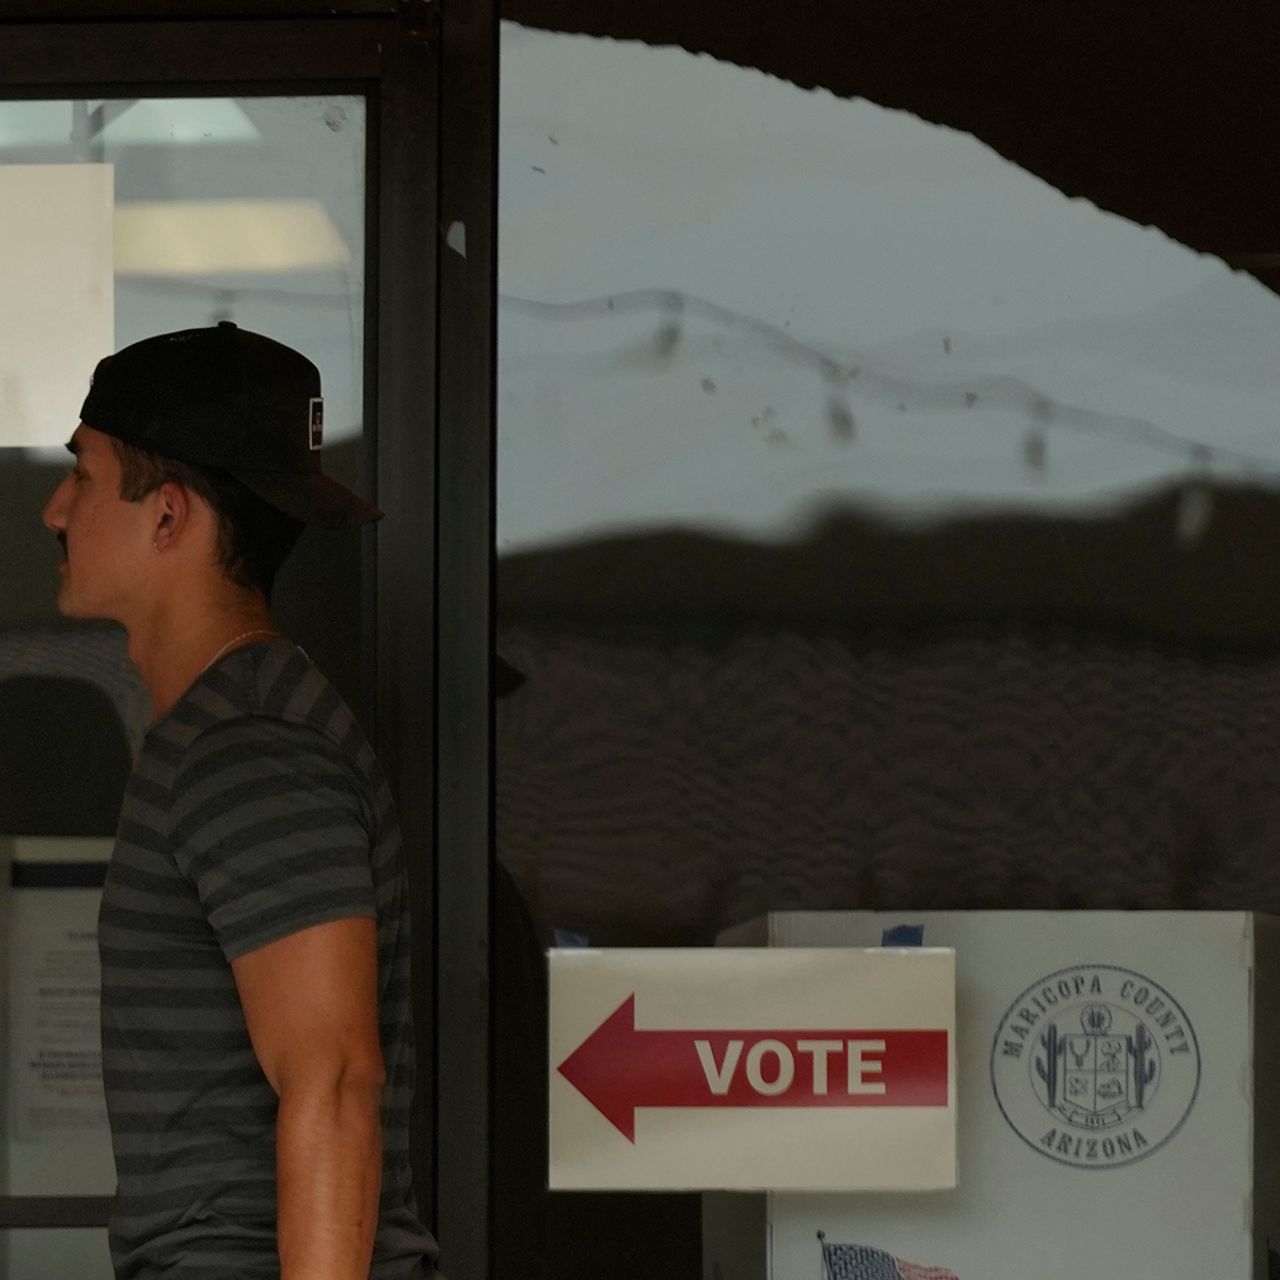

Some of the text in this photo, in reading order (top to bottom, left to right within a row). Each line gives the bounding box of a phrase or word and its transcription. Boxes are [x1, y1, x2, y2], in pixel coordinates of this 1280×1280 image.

[1002, 974, 1192, 1059] MARICOPA COUNTY
[694, 1038, 887, 1097] VOTE
[1041, 1127, 1149, 1160] ARIZONA
